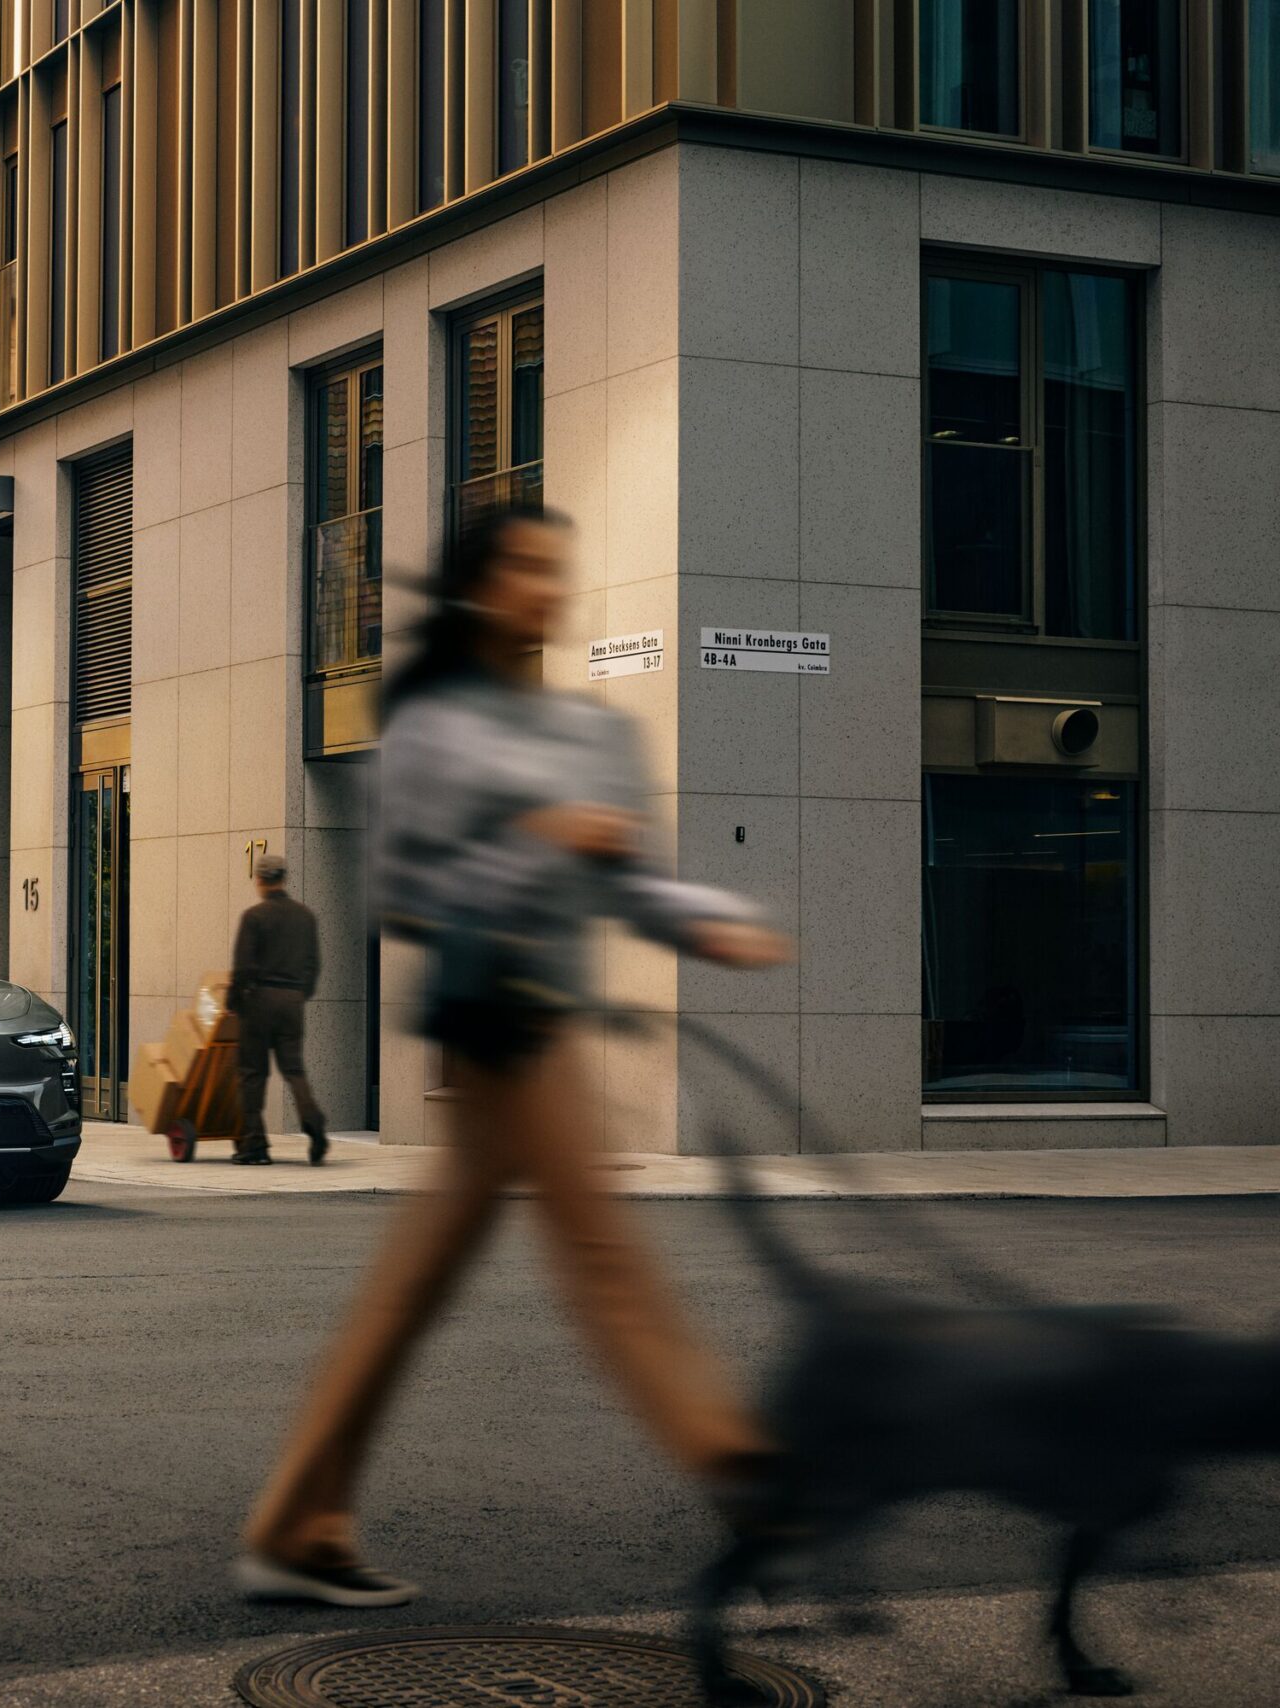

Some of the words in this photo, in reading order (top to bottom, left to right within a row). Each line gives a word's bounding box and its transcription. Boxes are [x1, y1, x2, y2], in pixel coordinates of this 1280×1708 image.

[591, 645, 607, 657] Anna
[642, 636, 658, 648] Gata
[714, 632, 742, 646] Ninni
[745, 634, 798, 652] Kronbergs
[801, 637, 827, 651] Gata
[643, 655, 661, 669] 13-17
[703, 653, 737, 666] 4B-4A
[22, 877, 39, 912] 15
